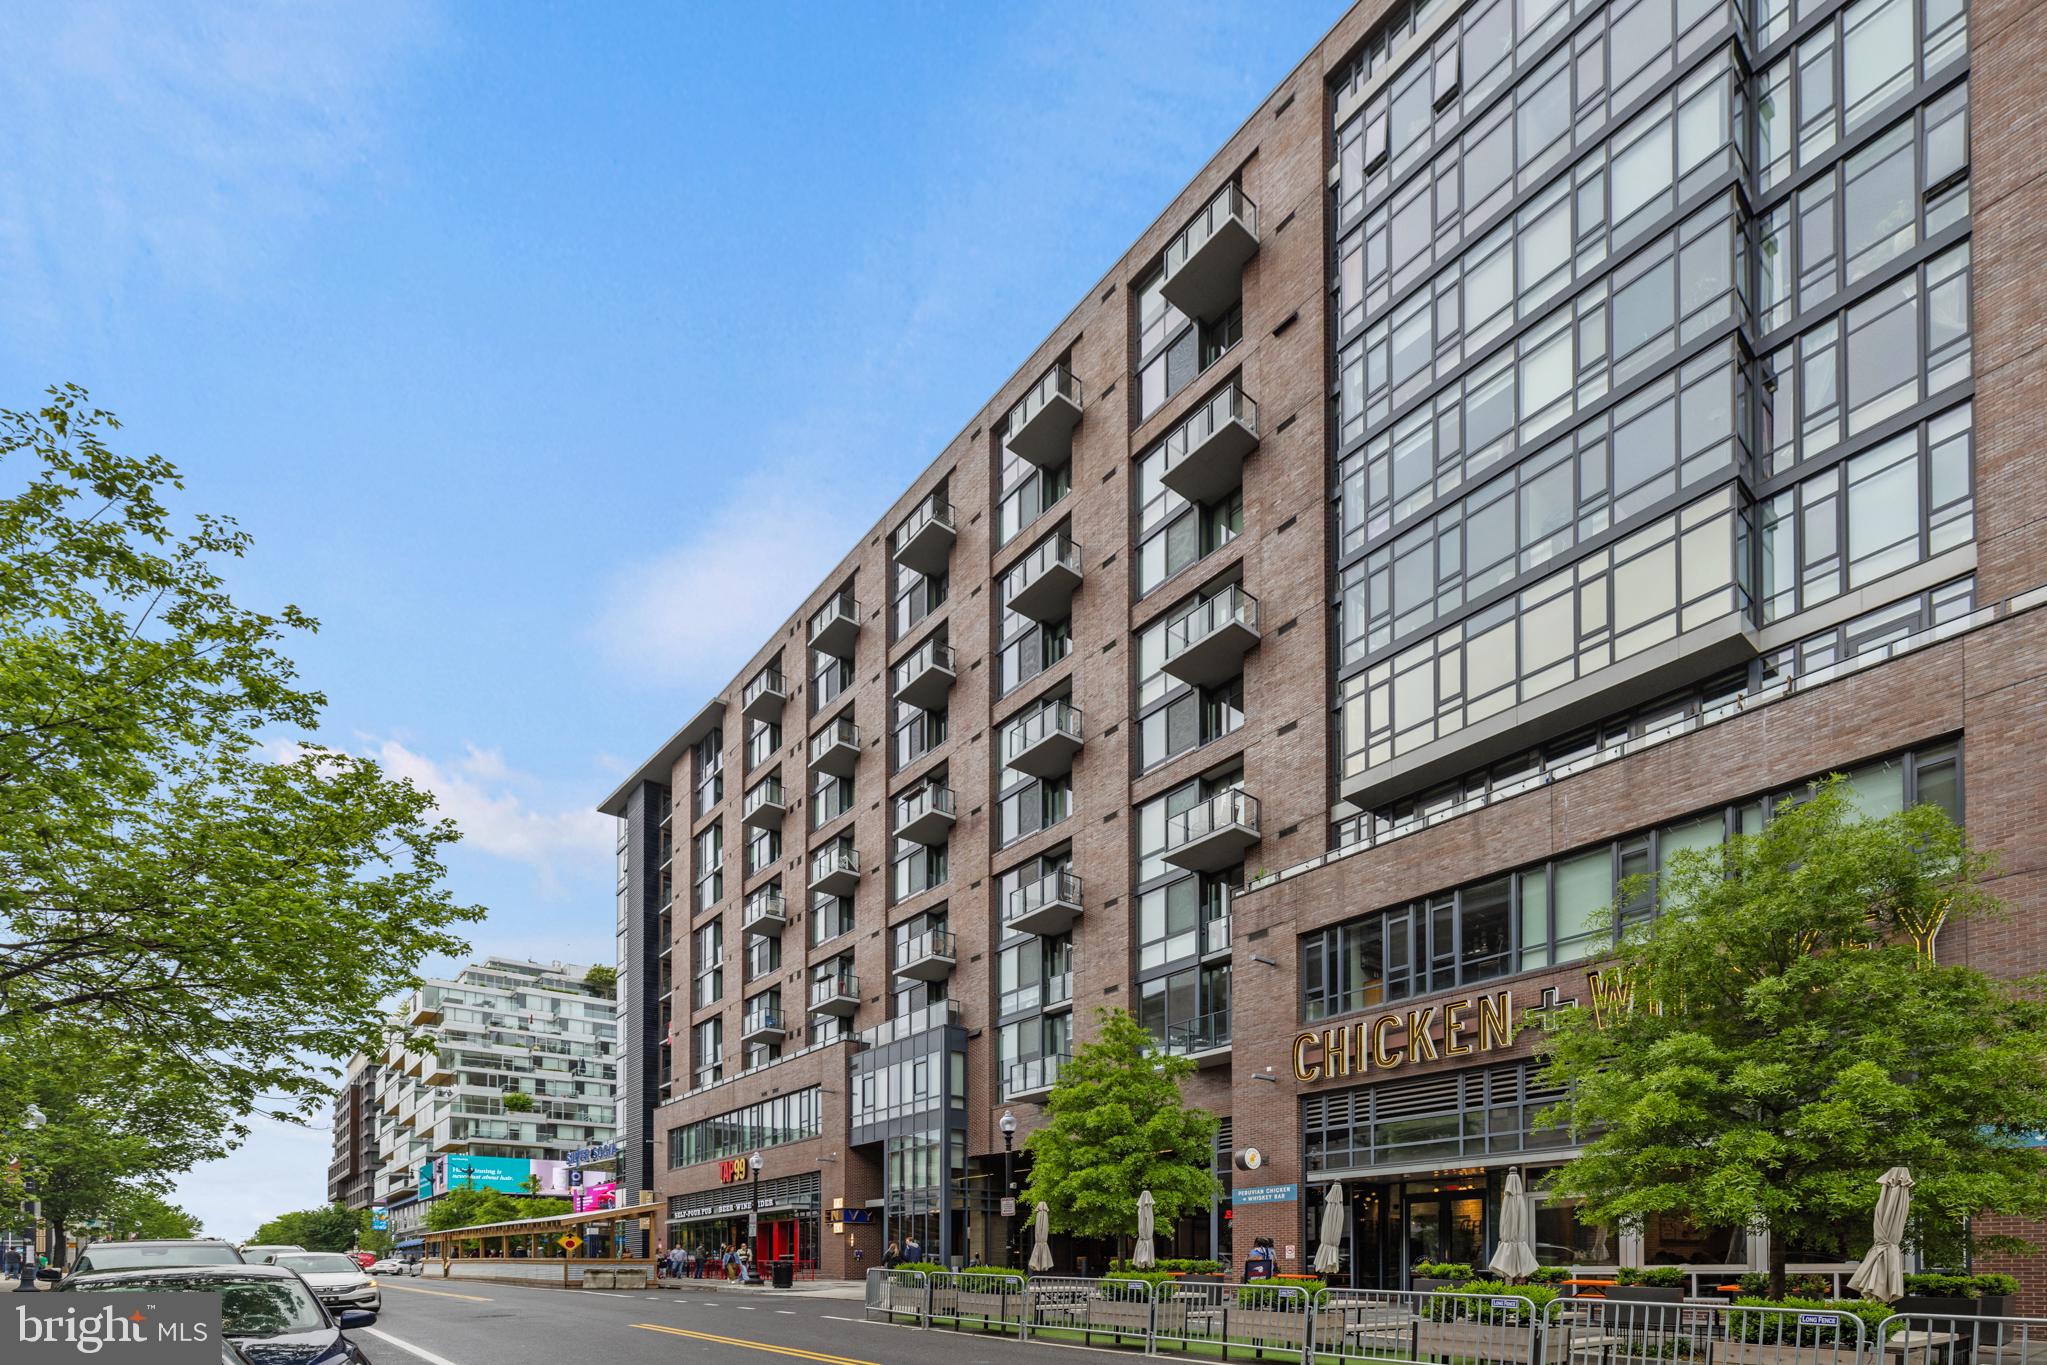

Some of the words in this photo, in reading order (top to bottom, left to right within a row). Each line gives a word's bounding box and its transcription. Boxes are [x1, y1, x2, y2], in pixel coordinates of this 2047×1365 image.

[1292, 989, 1513, 1083] CHICKEN
[719, 1158, 746, 1184] TAP99
[674, 1209, 700, 1219] SELF-POUR
[718, 1204, 734, 1213] BEER
[736, 1201, 752, 1210] WINE
[757, 1198, 774, 1208] IDER
[1802, 1315, 1817, 1323] LONG
[1818, 1316, 1836, 1324] FENCE
